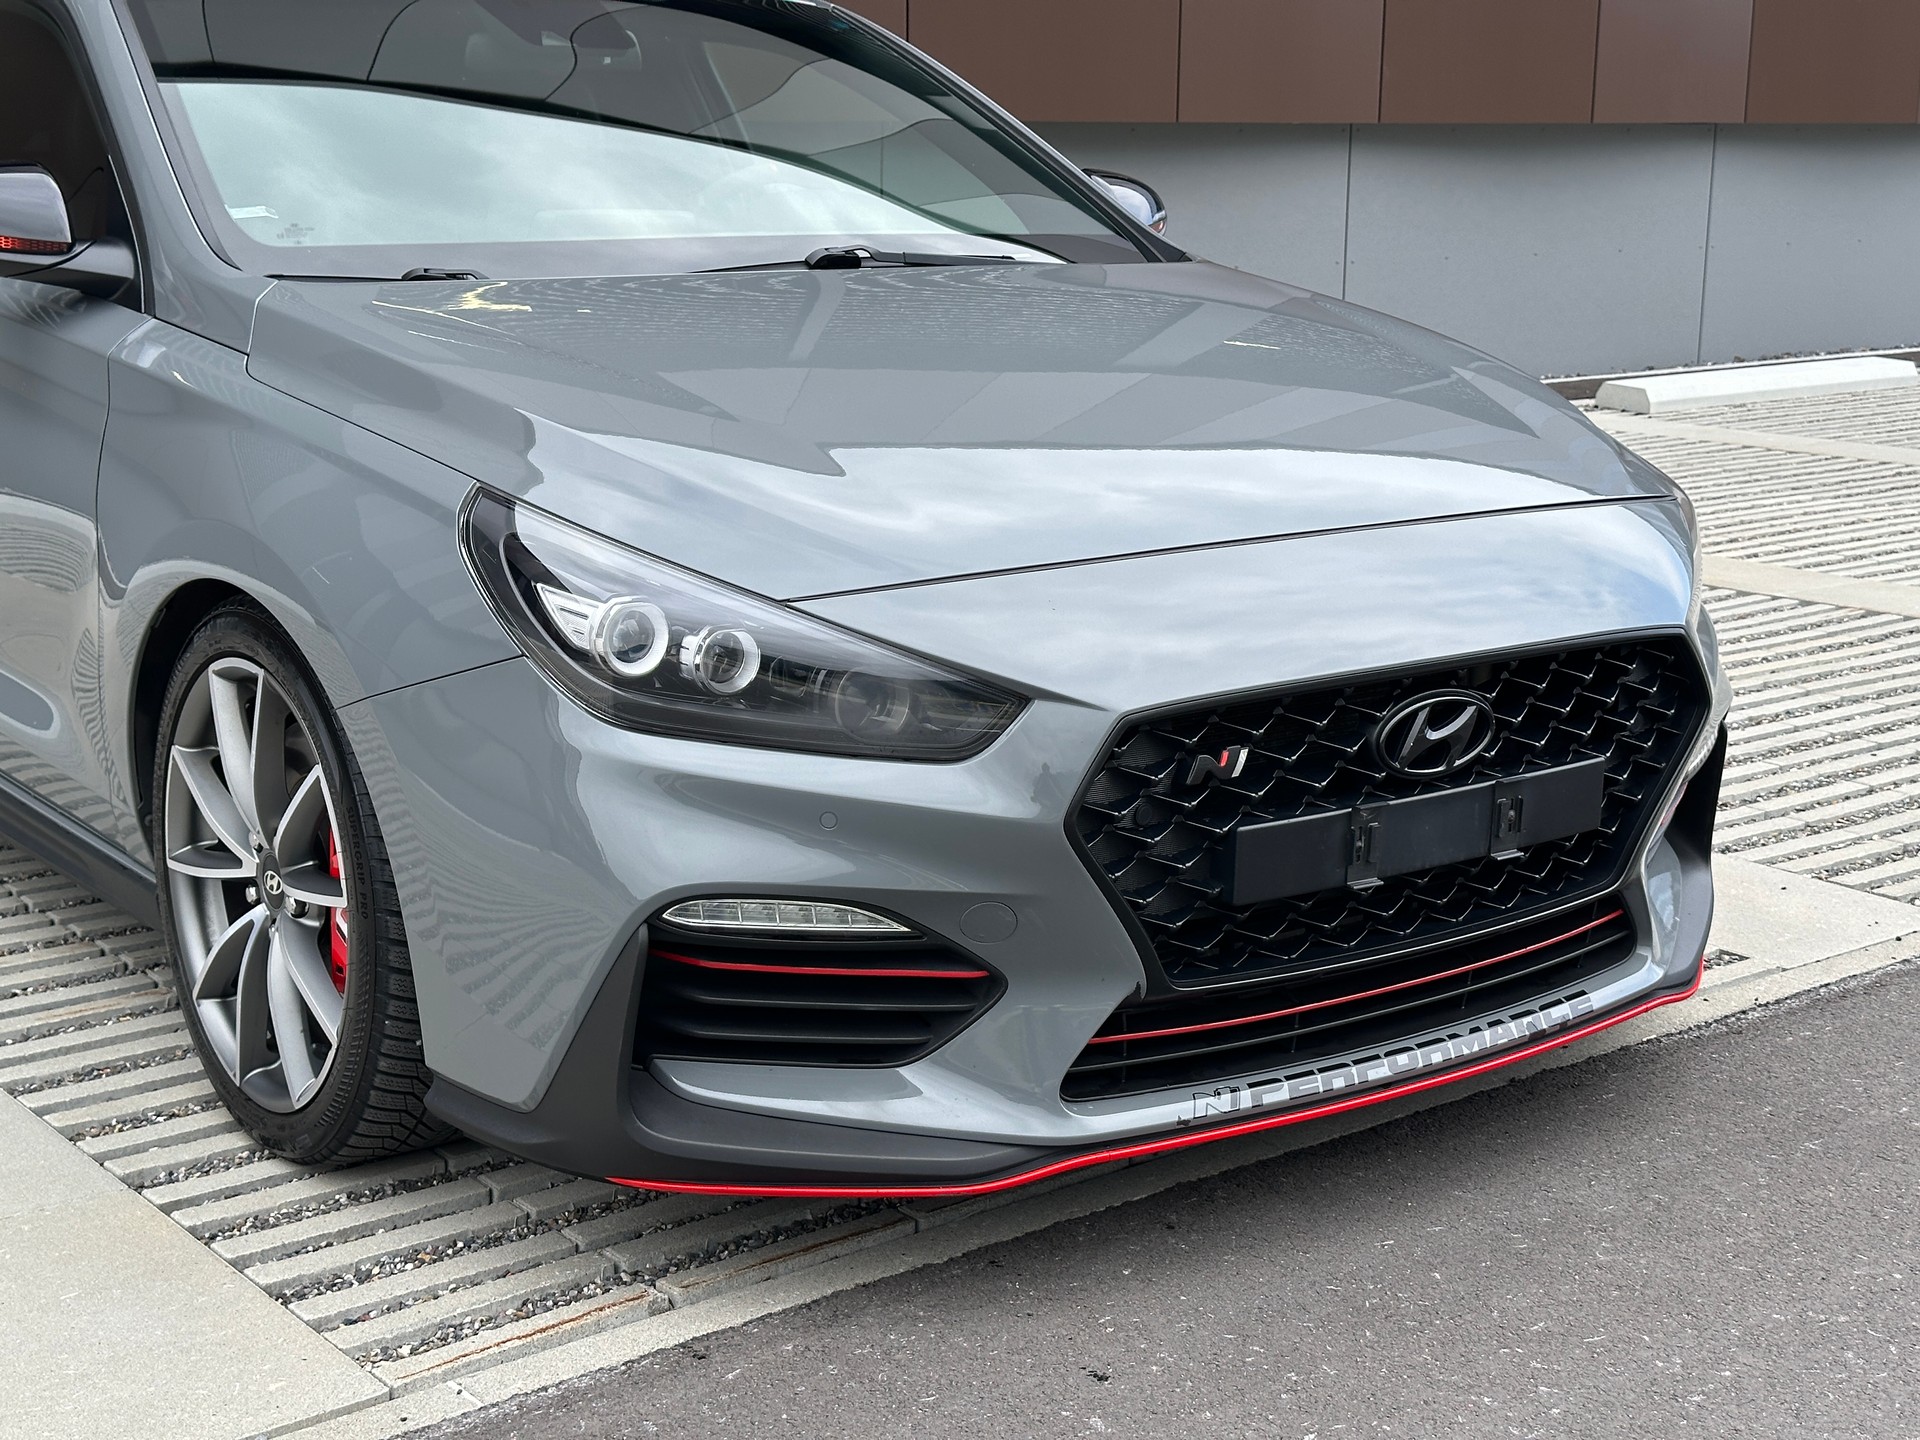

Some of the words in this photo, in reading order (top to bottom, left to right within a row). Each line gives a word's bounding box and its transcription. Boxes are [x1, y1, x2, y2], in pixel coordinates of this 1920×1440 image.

[346, 806, 366, 886] SUPERGRIP
[359, 892, 369, 920] PRO
[1246, 988, 1594, 1109] PERFORMANCE
